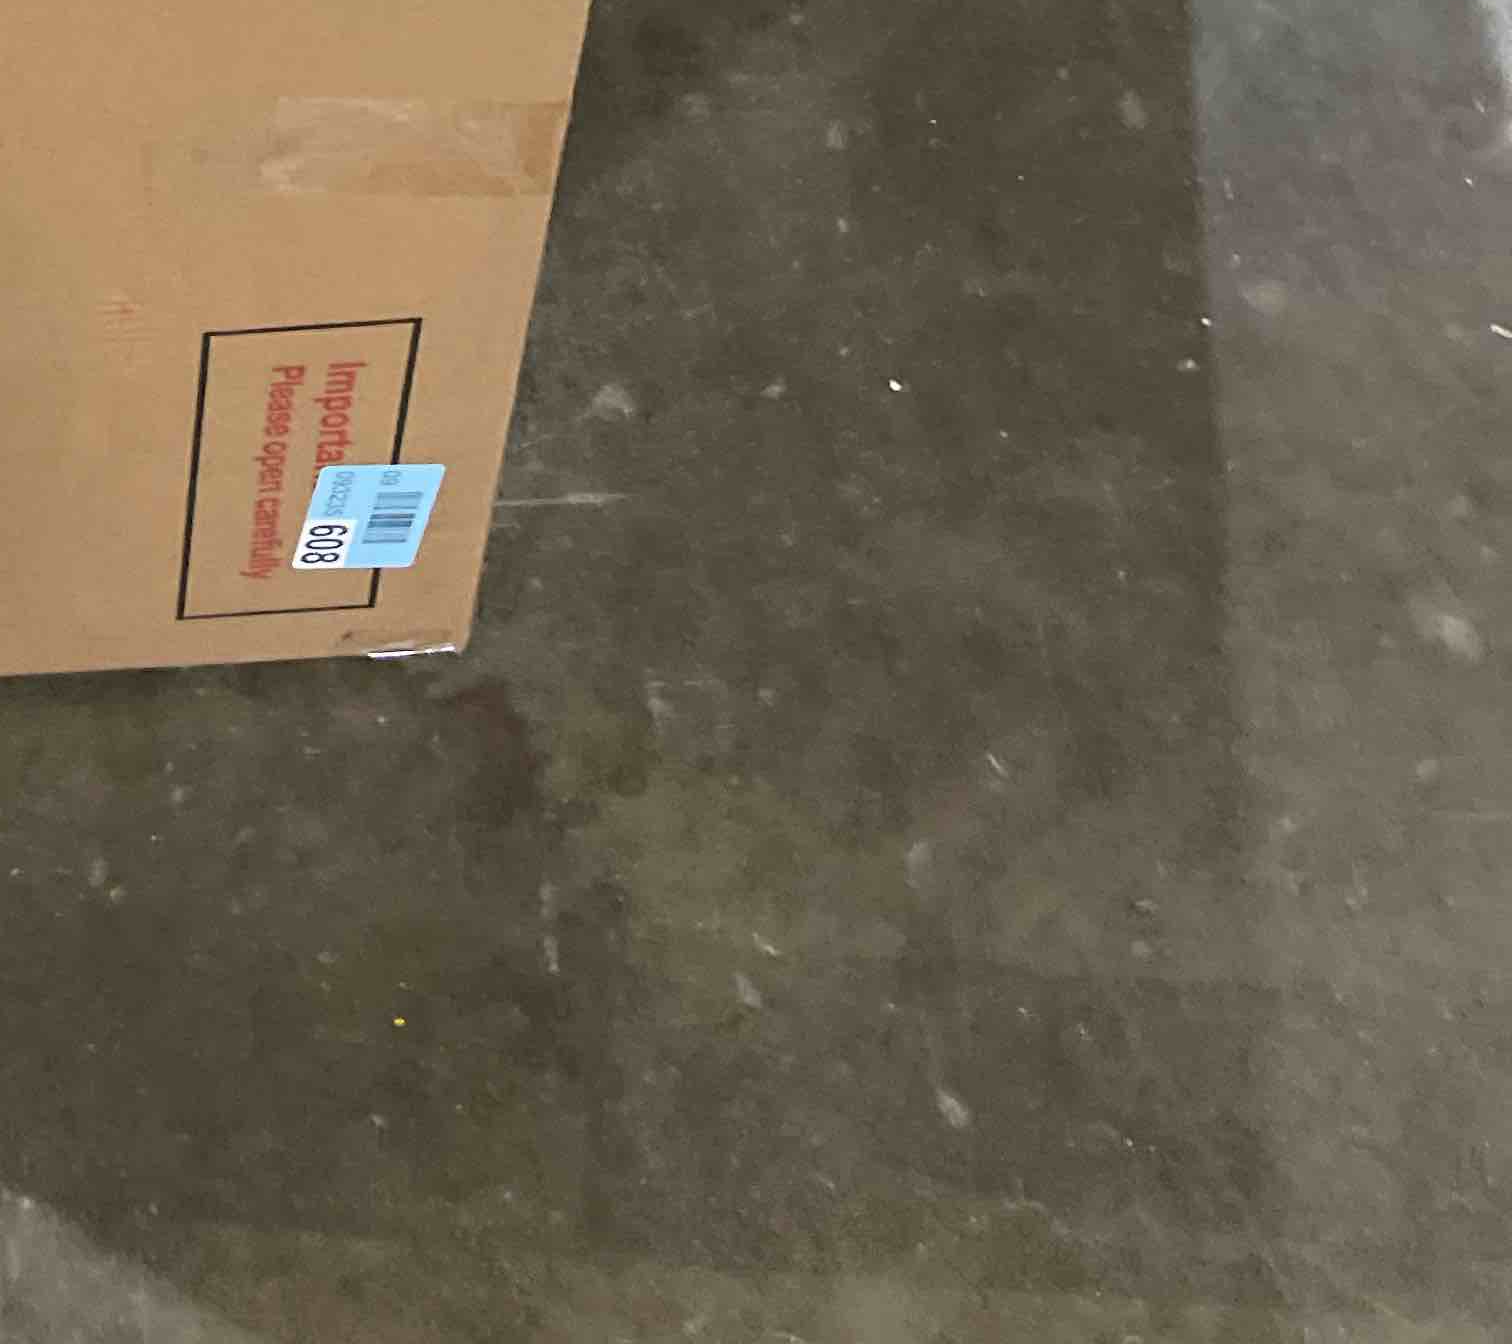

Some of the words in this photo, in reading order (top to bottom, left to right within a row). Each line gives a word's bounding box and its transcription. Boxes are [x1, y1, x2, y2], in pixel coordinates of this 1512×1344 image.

[266, 364, 305, 436] Please
[314, 361, 368, 484] Importa
[251, 439, 287, 500] open
[240, 500, 284, 580] carefully
[300, 523, 349, 565] 608
